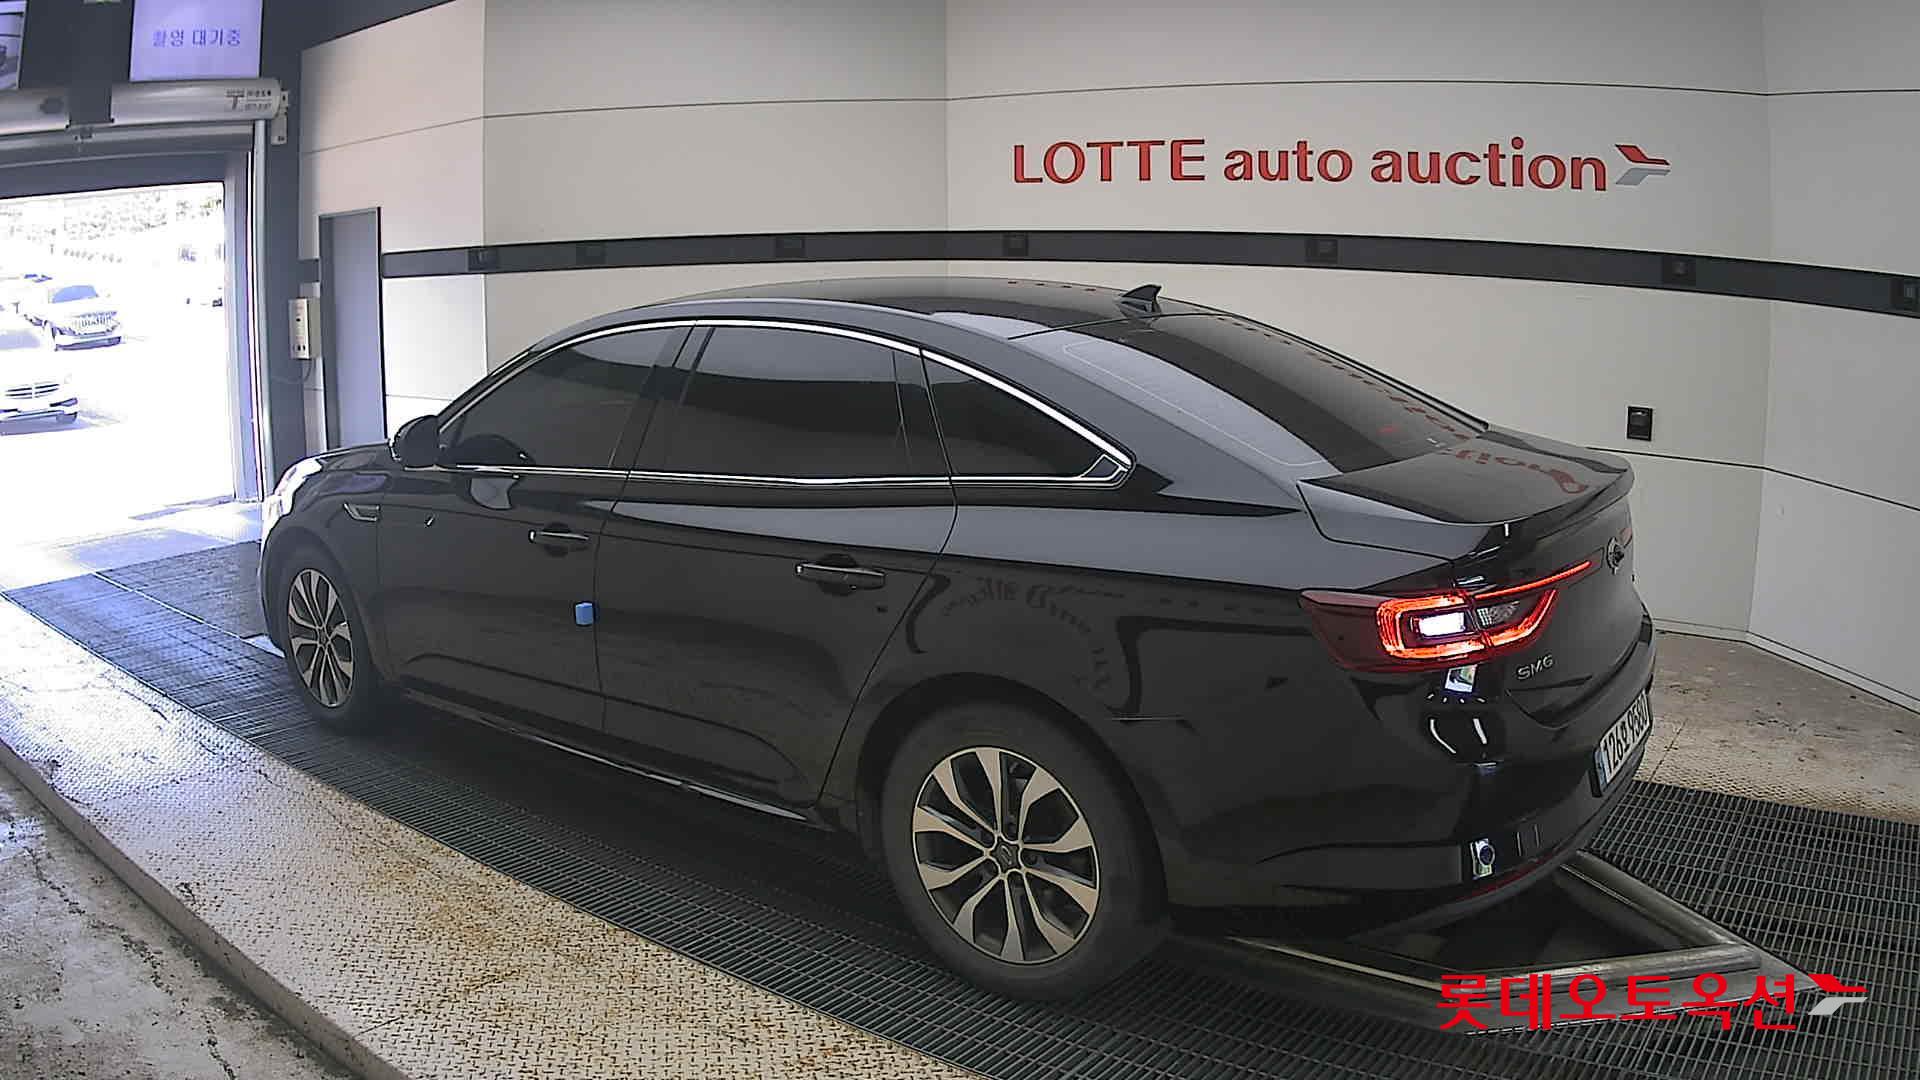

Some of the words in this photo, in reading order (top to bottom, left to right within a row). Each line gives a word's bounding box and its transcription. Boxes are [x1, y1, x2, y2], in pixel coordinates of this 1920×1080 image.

[192, 29, 241, 47] 대기중
[1013, 138, 1206, 185] LOTTE
[1222, 139, 1354, 183] auto
[1370, 136, 1608, 191] auction
[1517, 653, 1553, 680] SM6
